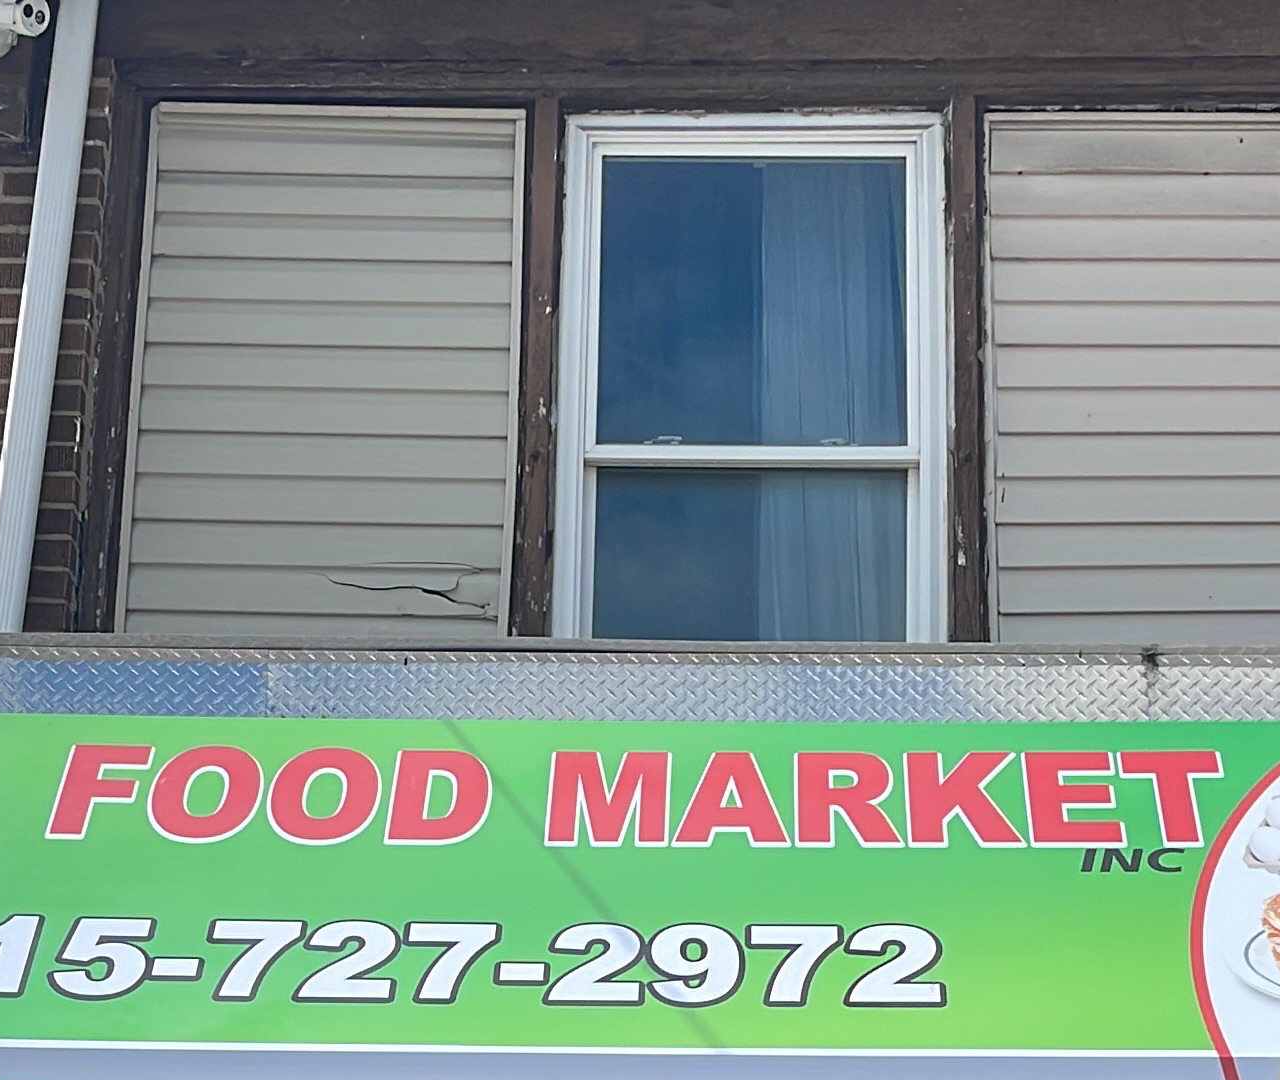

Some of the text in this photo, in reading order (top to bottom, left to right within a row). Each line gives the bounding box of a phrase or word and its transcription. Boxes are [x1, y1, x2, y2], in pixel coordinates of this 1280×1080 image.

[44, 744, 1224, 849] FOOD MARKET
[1080, 848, 1186, 873] INC
